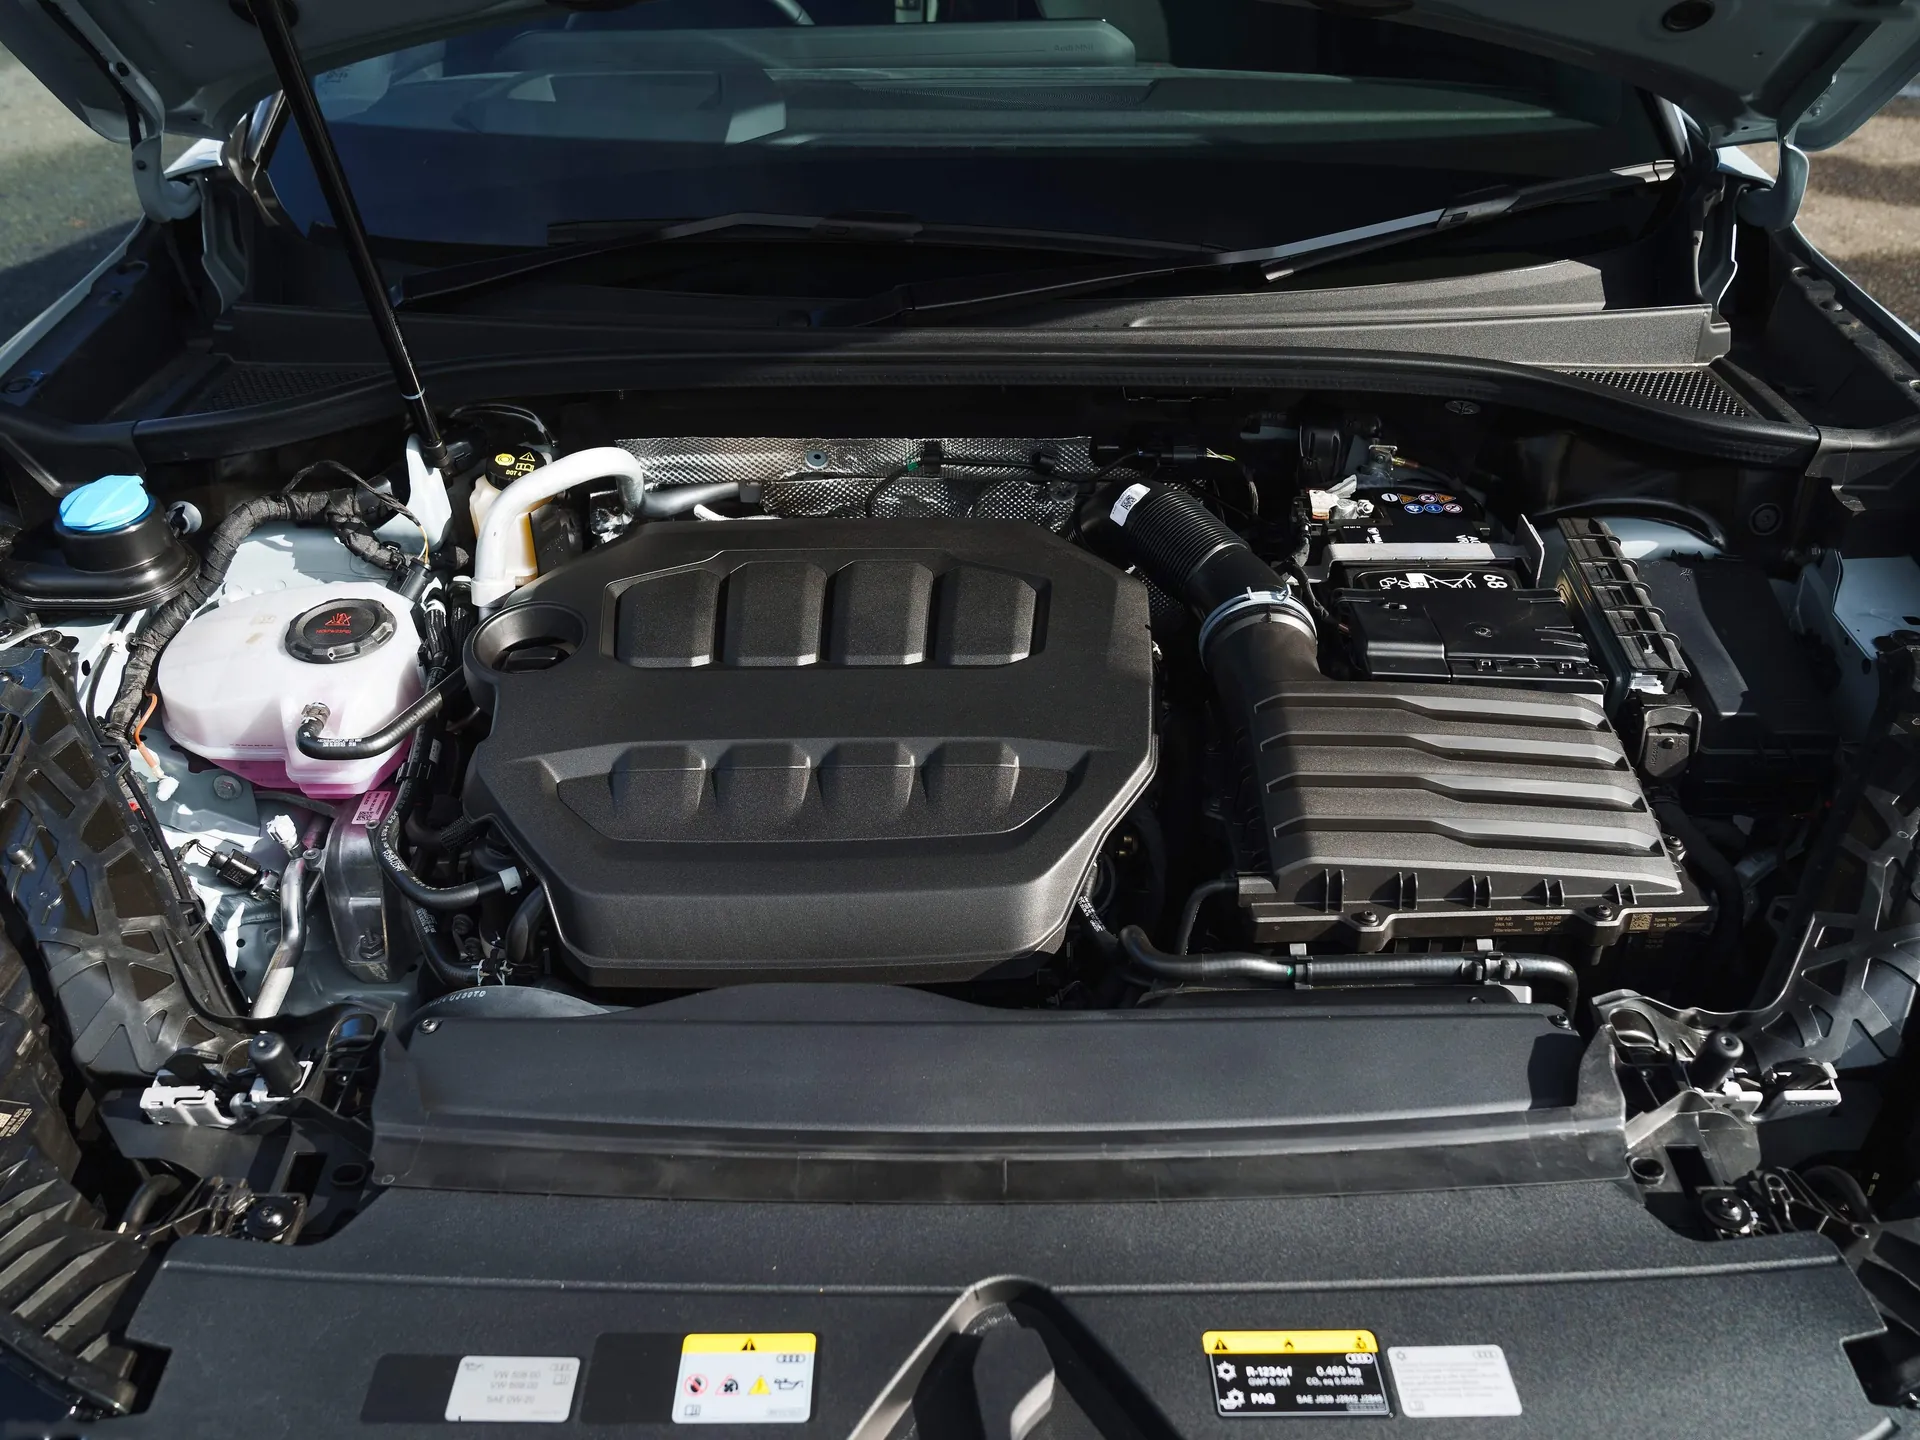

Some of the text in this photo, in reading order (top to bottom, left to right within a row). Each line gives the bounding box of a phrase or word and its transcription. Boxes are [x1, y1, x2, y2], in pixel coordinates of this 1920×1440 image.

[1483, 574, 1508, 589] 68
[1245, 1366, 1293, 1378] R-1234yf
[1347, 1365, 1362, 1378] kg
[1250, 1392, 1276, 1405] PAG
[1295, 1394, 1314, 1405] SAE
